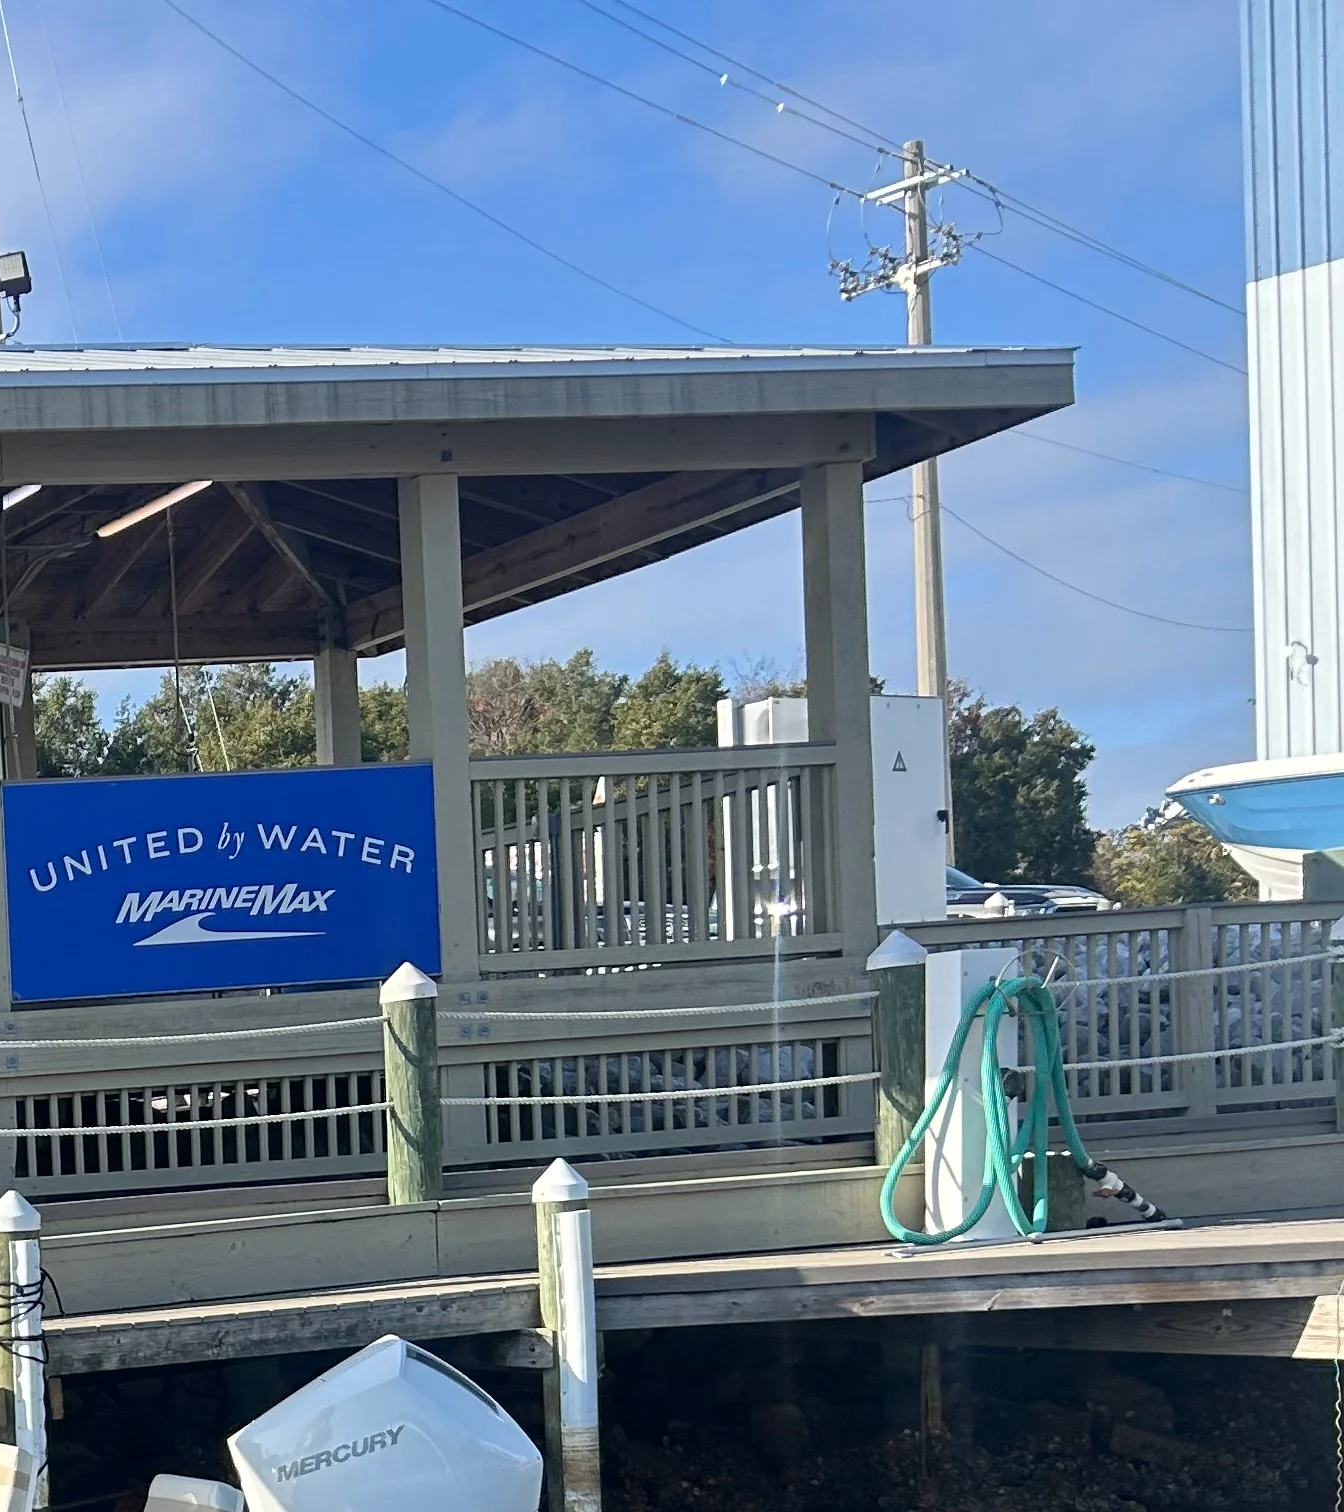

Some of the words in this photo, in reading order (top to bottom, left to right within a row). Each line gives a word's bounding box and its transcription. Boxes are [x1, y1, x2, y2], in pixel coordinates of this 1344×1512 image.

[29, 827, 204, 892] UNITED
[217, 822, 246, 860] by
[257, 824, 415, 874] WATER
[277, 1424, 405, 1483] MERCURY
